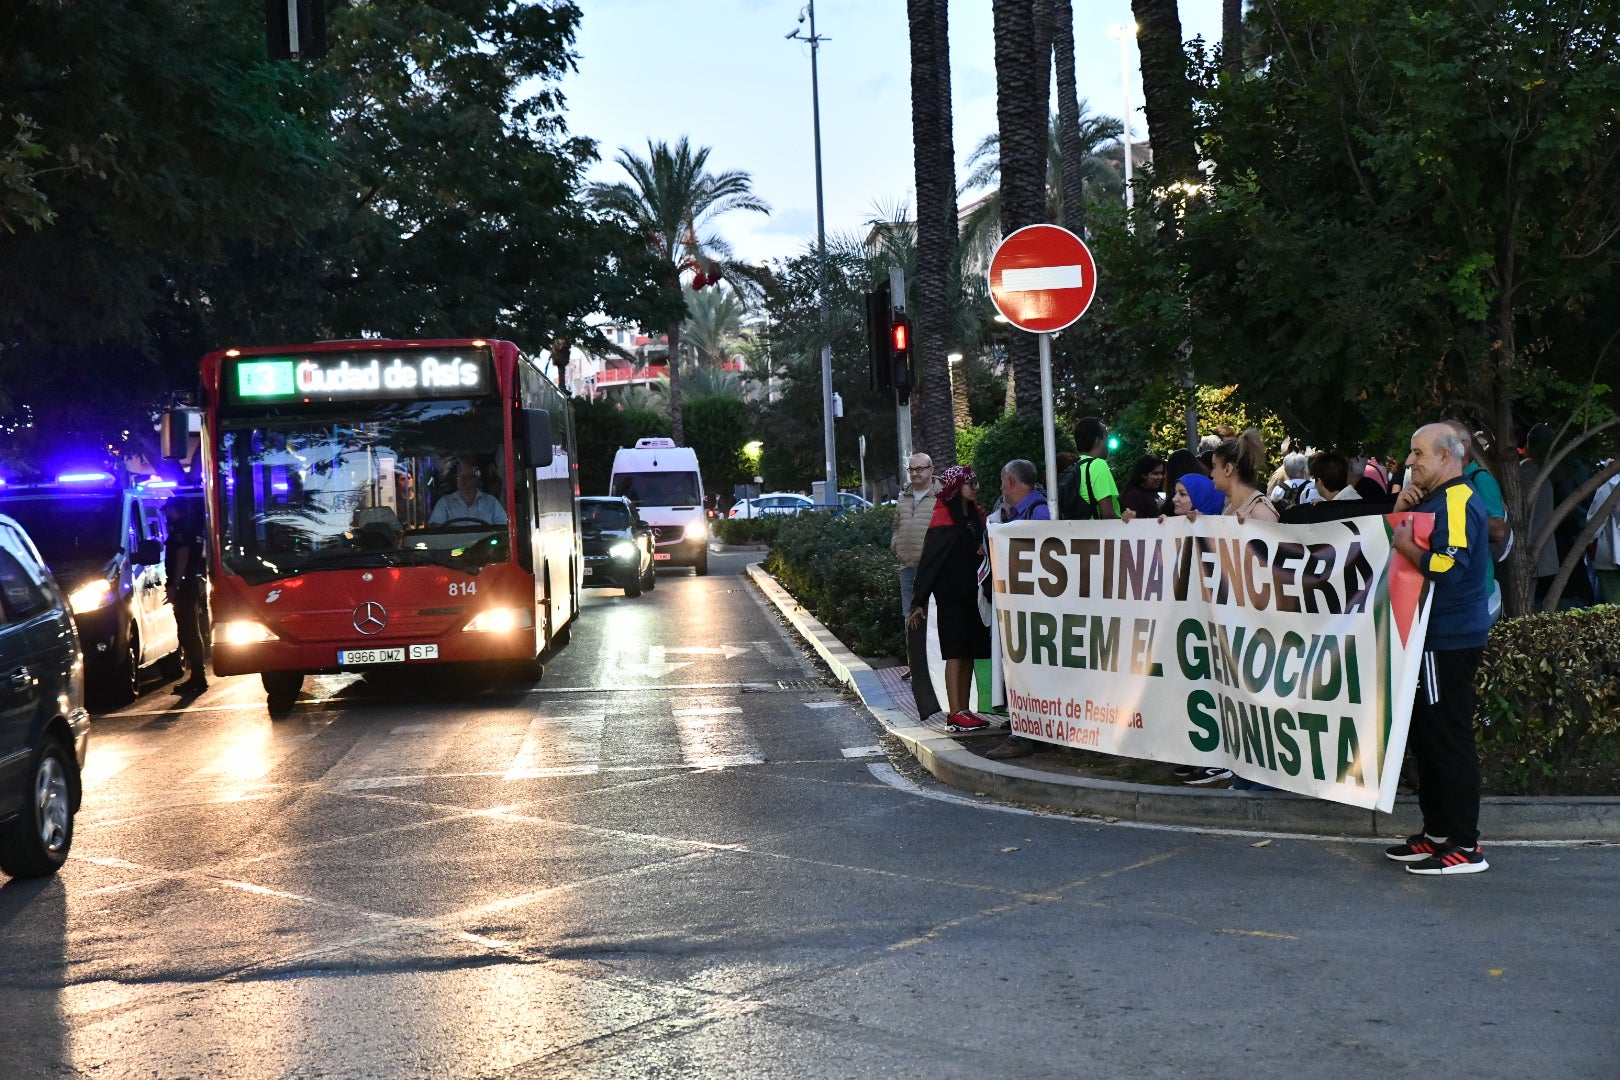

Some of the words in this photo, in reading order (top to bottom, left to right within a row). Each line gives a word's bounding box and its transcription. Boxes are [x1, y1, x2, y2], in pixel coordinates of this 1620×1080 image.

[255, 363, 276, 394] 3
[296, 359, 381, 392] Ciudad
[384, 358, 418, 389] de
[1172, 520, 1374, 615] VENCERÀ
[448, 581, 477, 596] 814
[347, 651, 375, 664] 9966
[379, 649, 401, 662] DMZ
[1130, 617, 1164, 678] EL
[1176, 617, 1362, 705] GENOCIDI
[1009, 688, 1063, 717] Moviment
[1065, 697, 1082, 719] de
[1011, 711, 1044, 737] Global
[1186, 689, 1365, 788] SIONISTA
